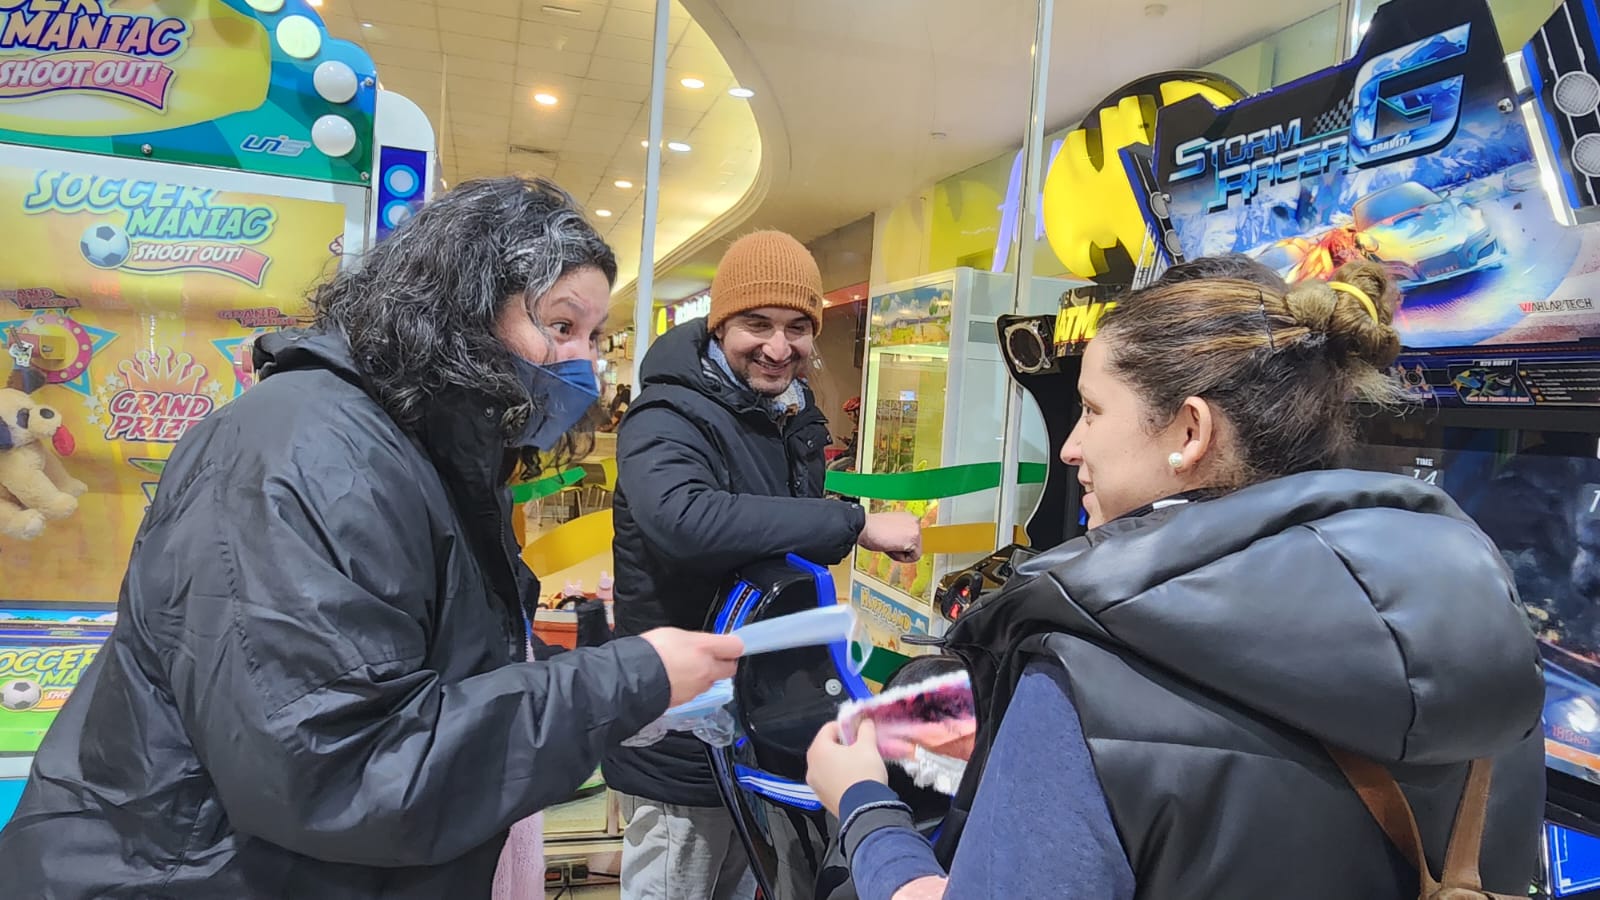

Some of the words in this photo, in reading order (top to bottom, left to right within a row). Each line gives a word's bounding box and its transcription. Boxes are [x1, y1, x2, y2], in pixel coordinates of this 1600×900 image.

[0, 9, 187, 56] MANIAC
[0, 60, 93, 87] SHOOT
[94, 61, 162, 87] OUT!
[1168, 117, 1302, 182] STORM
[1369, 135, 1412, 154] GRAVITY
[1206, 135, 1350, 210] RACER
[25, 170, 214, 209] SOCCER
[125, 206, 273, 240] MANIAC
[134, 244, 198, 261] SHOOT
[199, 246, 242, 263] OUT!
[111, 391, 213, 419] GRAND
[1416, 457, 1433, 467] TIME
